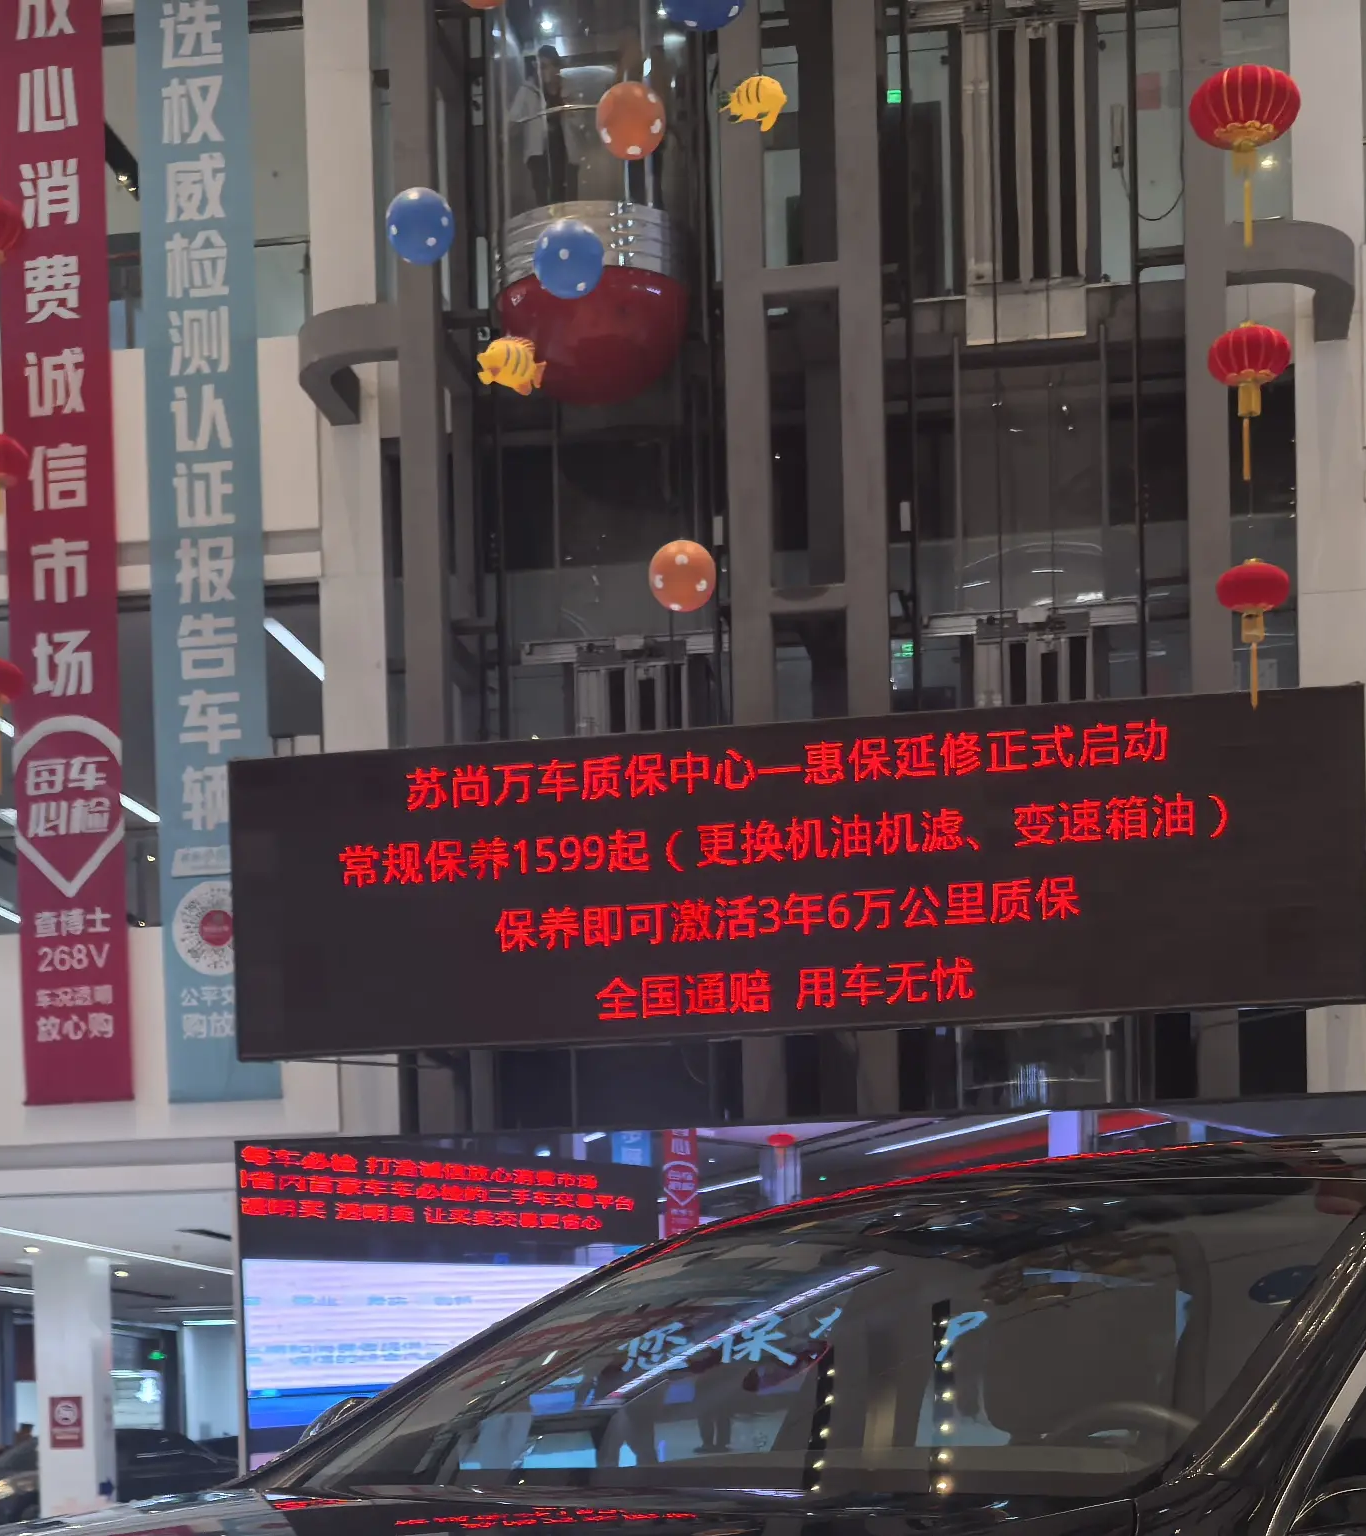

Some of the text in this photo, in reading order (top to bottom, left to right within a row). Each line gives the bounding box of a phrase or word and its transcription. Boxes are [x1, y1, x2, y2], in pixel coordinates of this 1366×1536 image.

[15, 0, 93, 697] 放心消费诚信市场
[159, 2, 242, 831] 选权威检测认证报告车辆
[35, 906, 111, 938] 查博士
[494, 876, 1081, 953] 保养即可激活3年6万公里质保
[37, 943, 111, 973] 268V
[595, 956, 975, 1021] 全国通赔 用车无忧
[36, 1011, 115, 1042] 放心购
